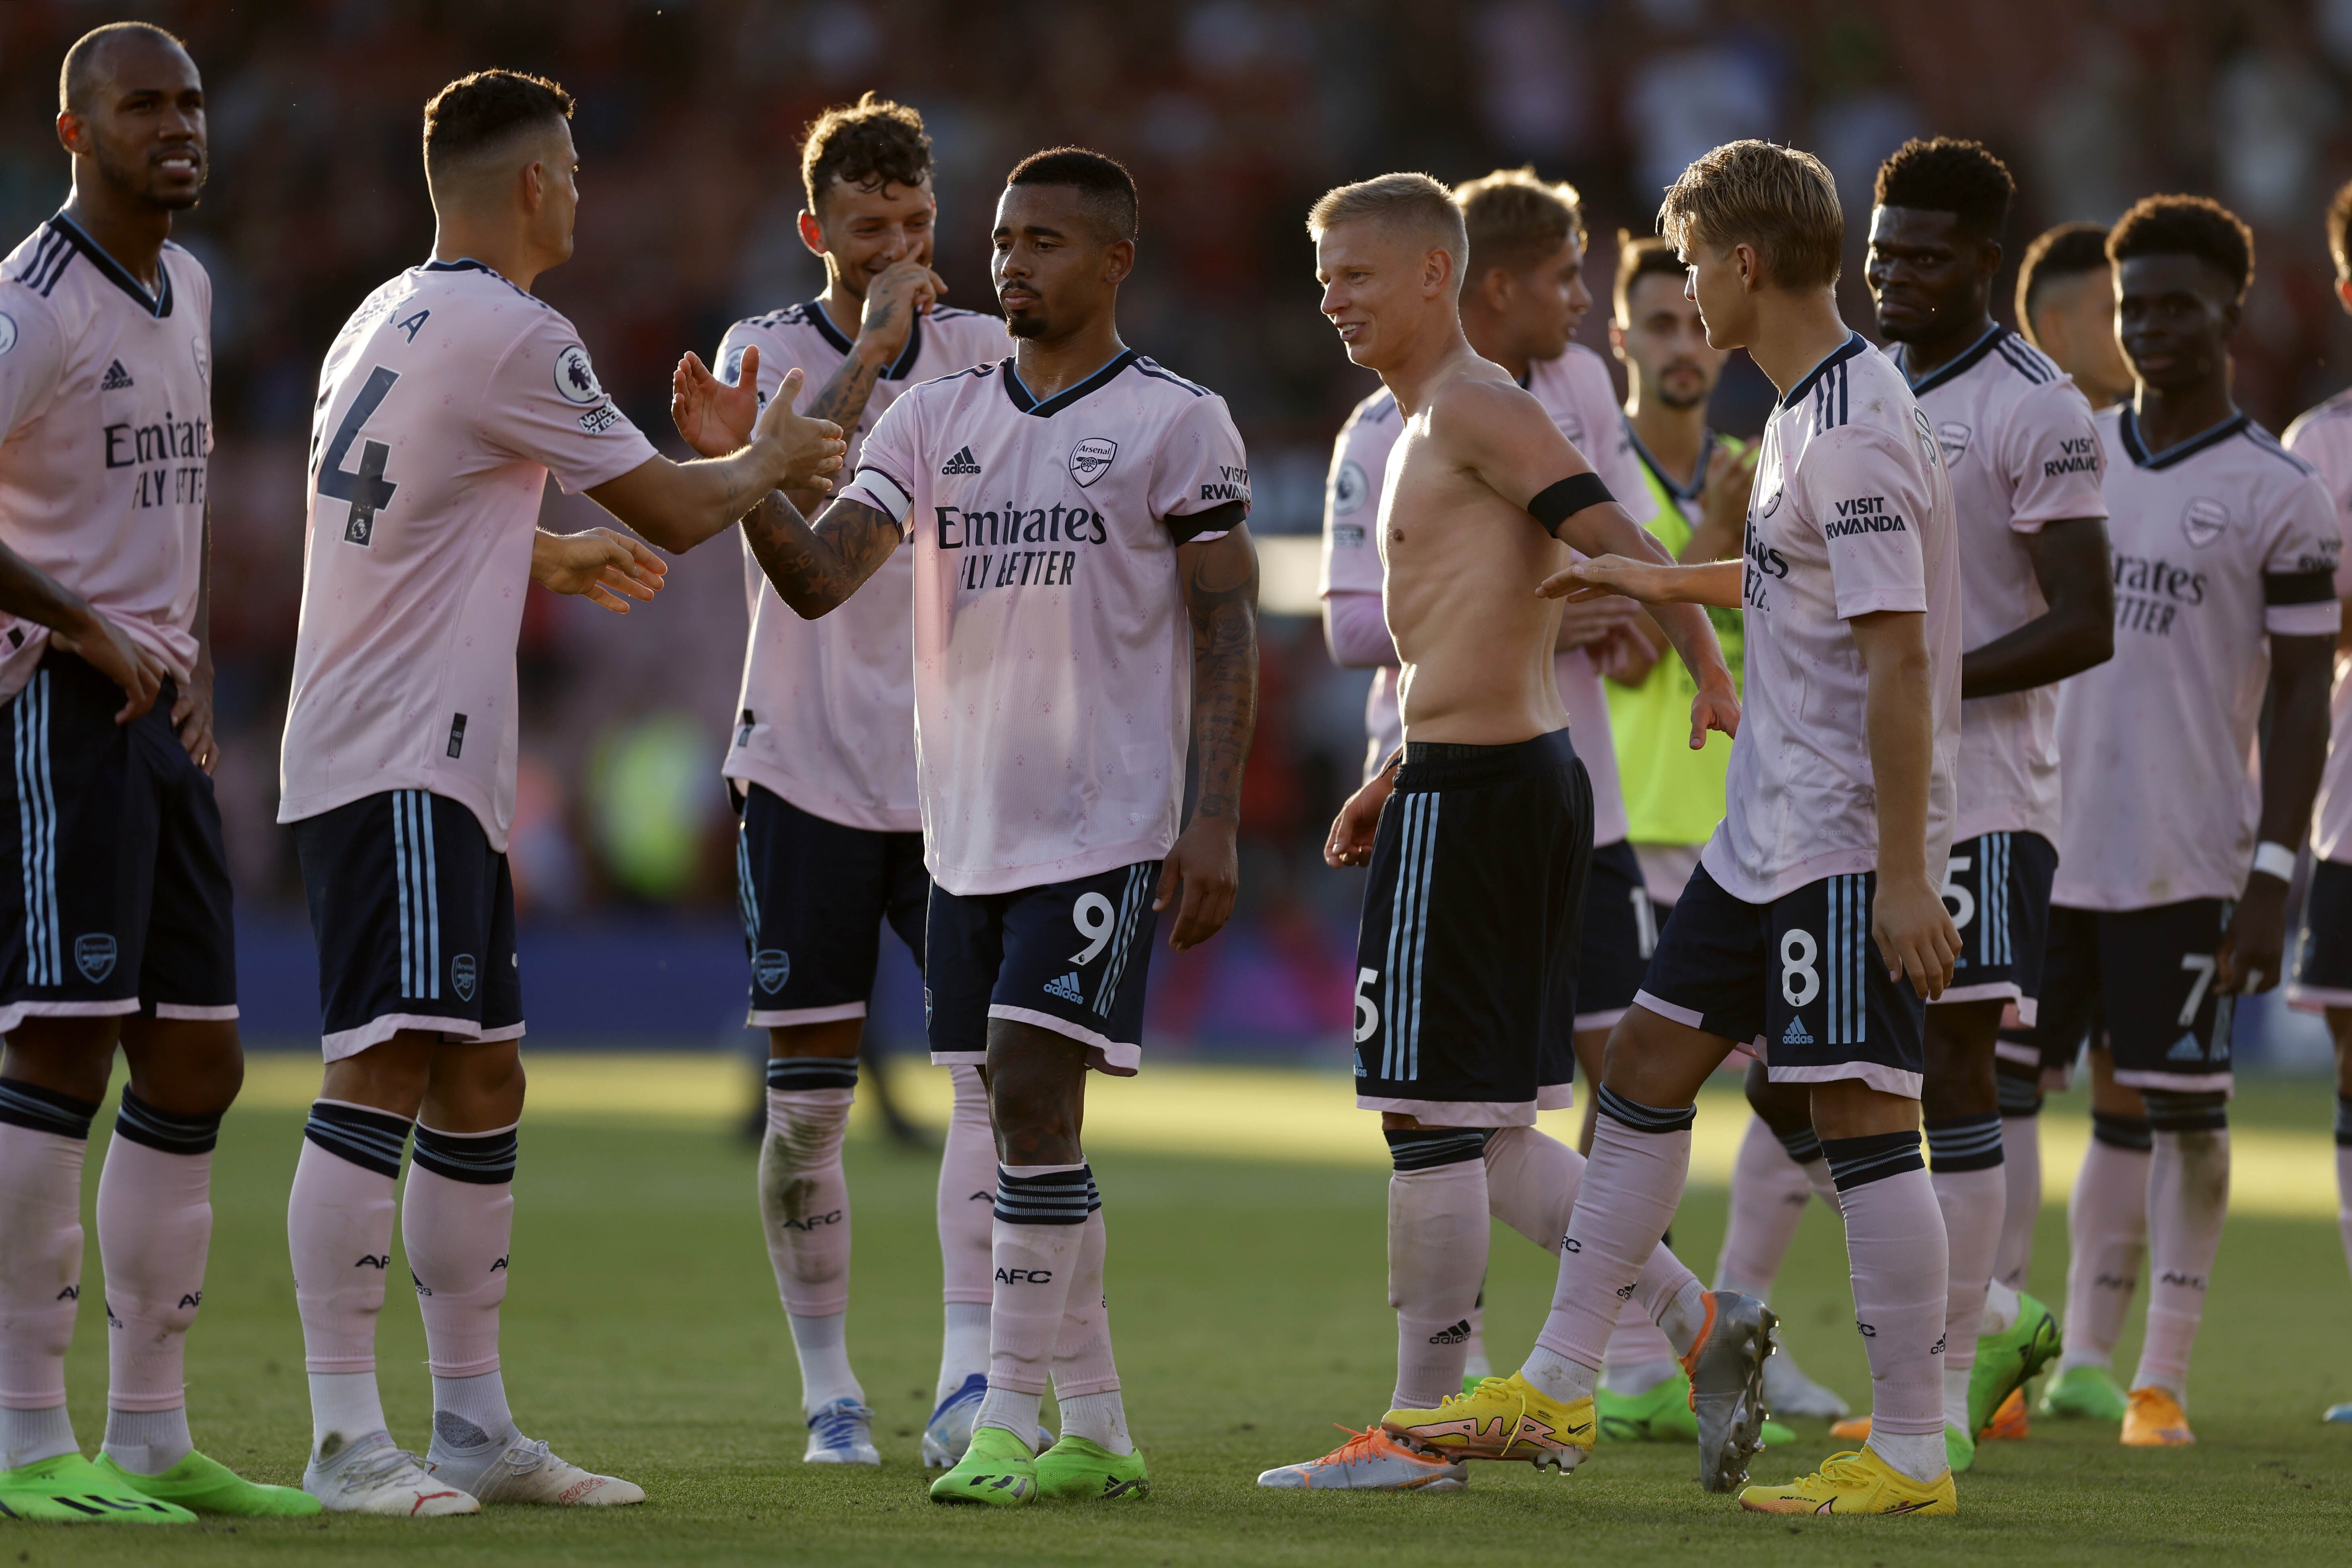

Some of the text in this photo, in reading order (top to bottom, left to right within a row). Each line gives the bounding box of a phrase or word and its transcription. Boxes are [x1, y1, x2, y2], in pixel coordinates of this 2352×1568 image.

[317, 363, 402, 548] 4
[1079, 445, 1110, 455] Arsenal
[942, 464, 981, 475] adidas
[1219, 466, 1248, 486] VISIT
[1201, 484, 1252, 506] RWAND
[1835, 497, 1884, 517] VISIT
[935, 501, 1106, 549] Emirates
[1825, 515, 1905, 540] RWANDA
[995, 551, 1076, 587] BETTER
[1068, 892, 1114, 966] 9
[1781, 929, 1820, 1007] 8
[1044, 983, 1084, 1005] adidas
[2177, 953, 2216, 1026] 7
[1783, 1032, 1814, 1045] adidas
[783, 1209, 842, 1231] AFC
[995, 1267, 1052, 1285] AFC
